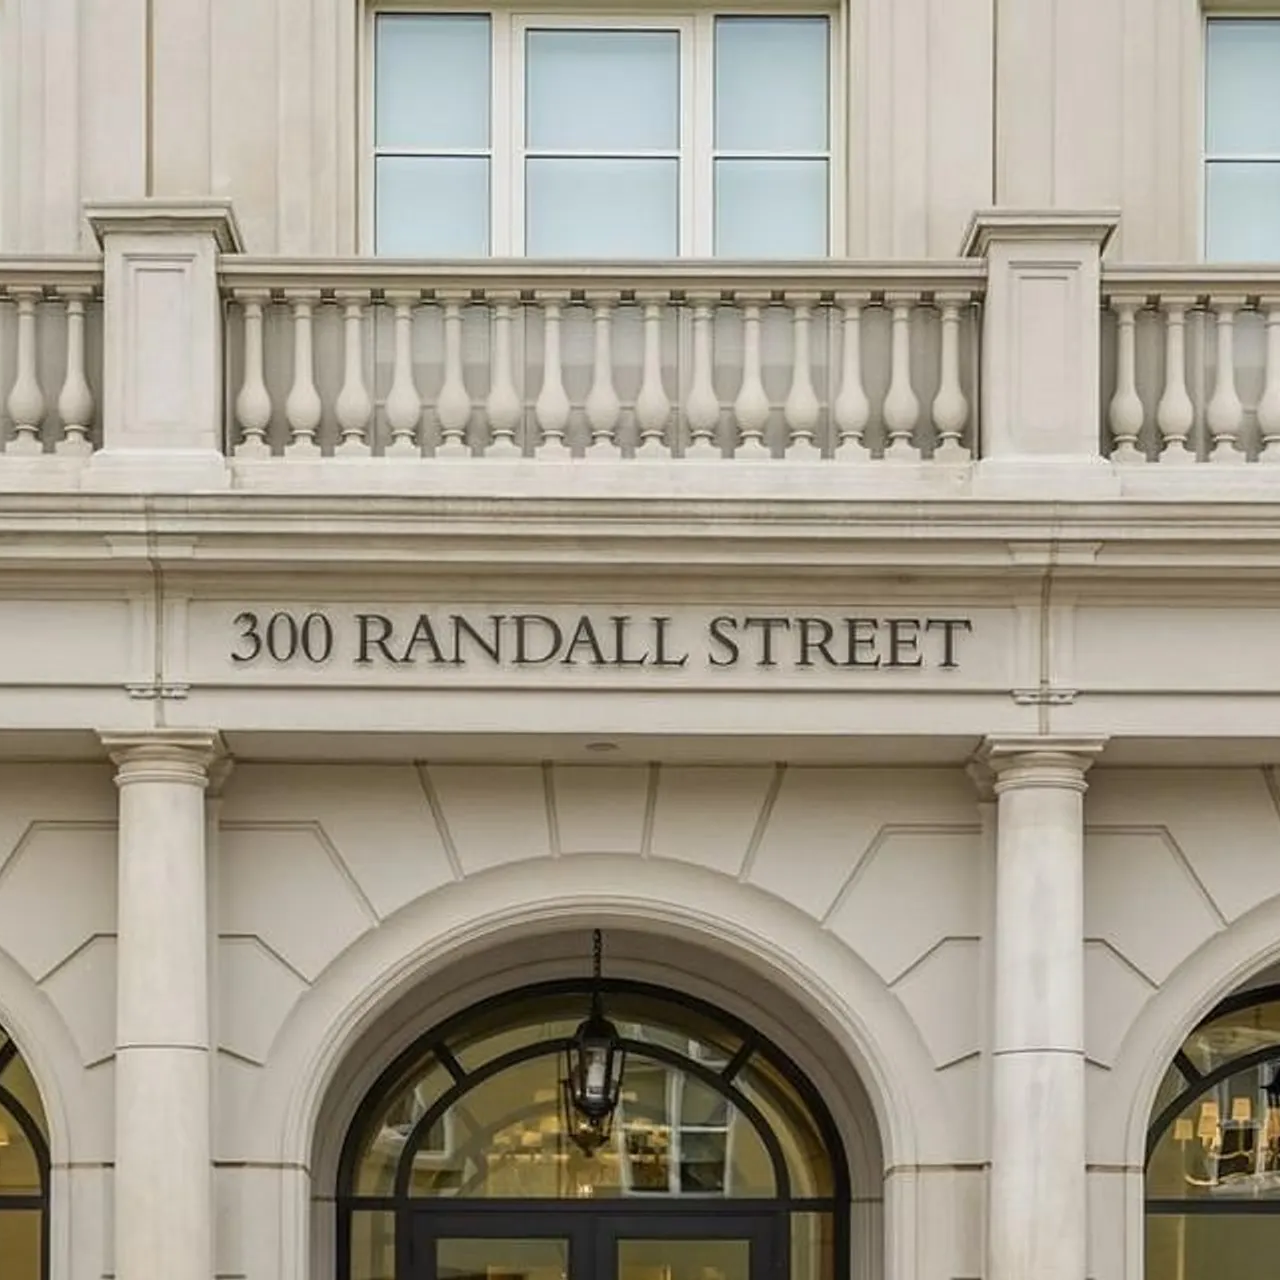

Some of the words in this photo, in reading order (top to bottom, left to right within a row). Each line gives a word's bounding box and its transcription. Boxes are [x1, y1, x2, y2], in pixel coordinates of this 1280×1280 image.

[230, 611, 334, 664] 300
[354, 614, 690, 666] RANDALL
[708, 616, 972, 668] STREET
